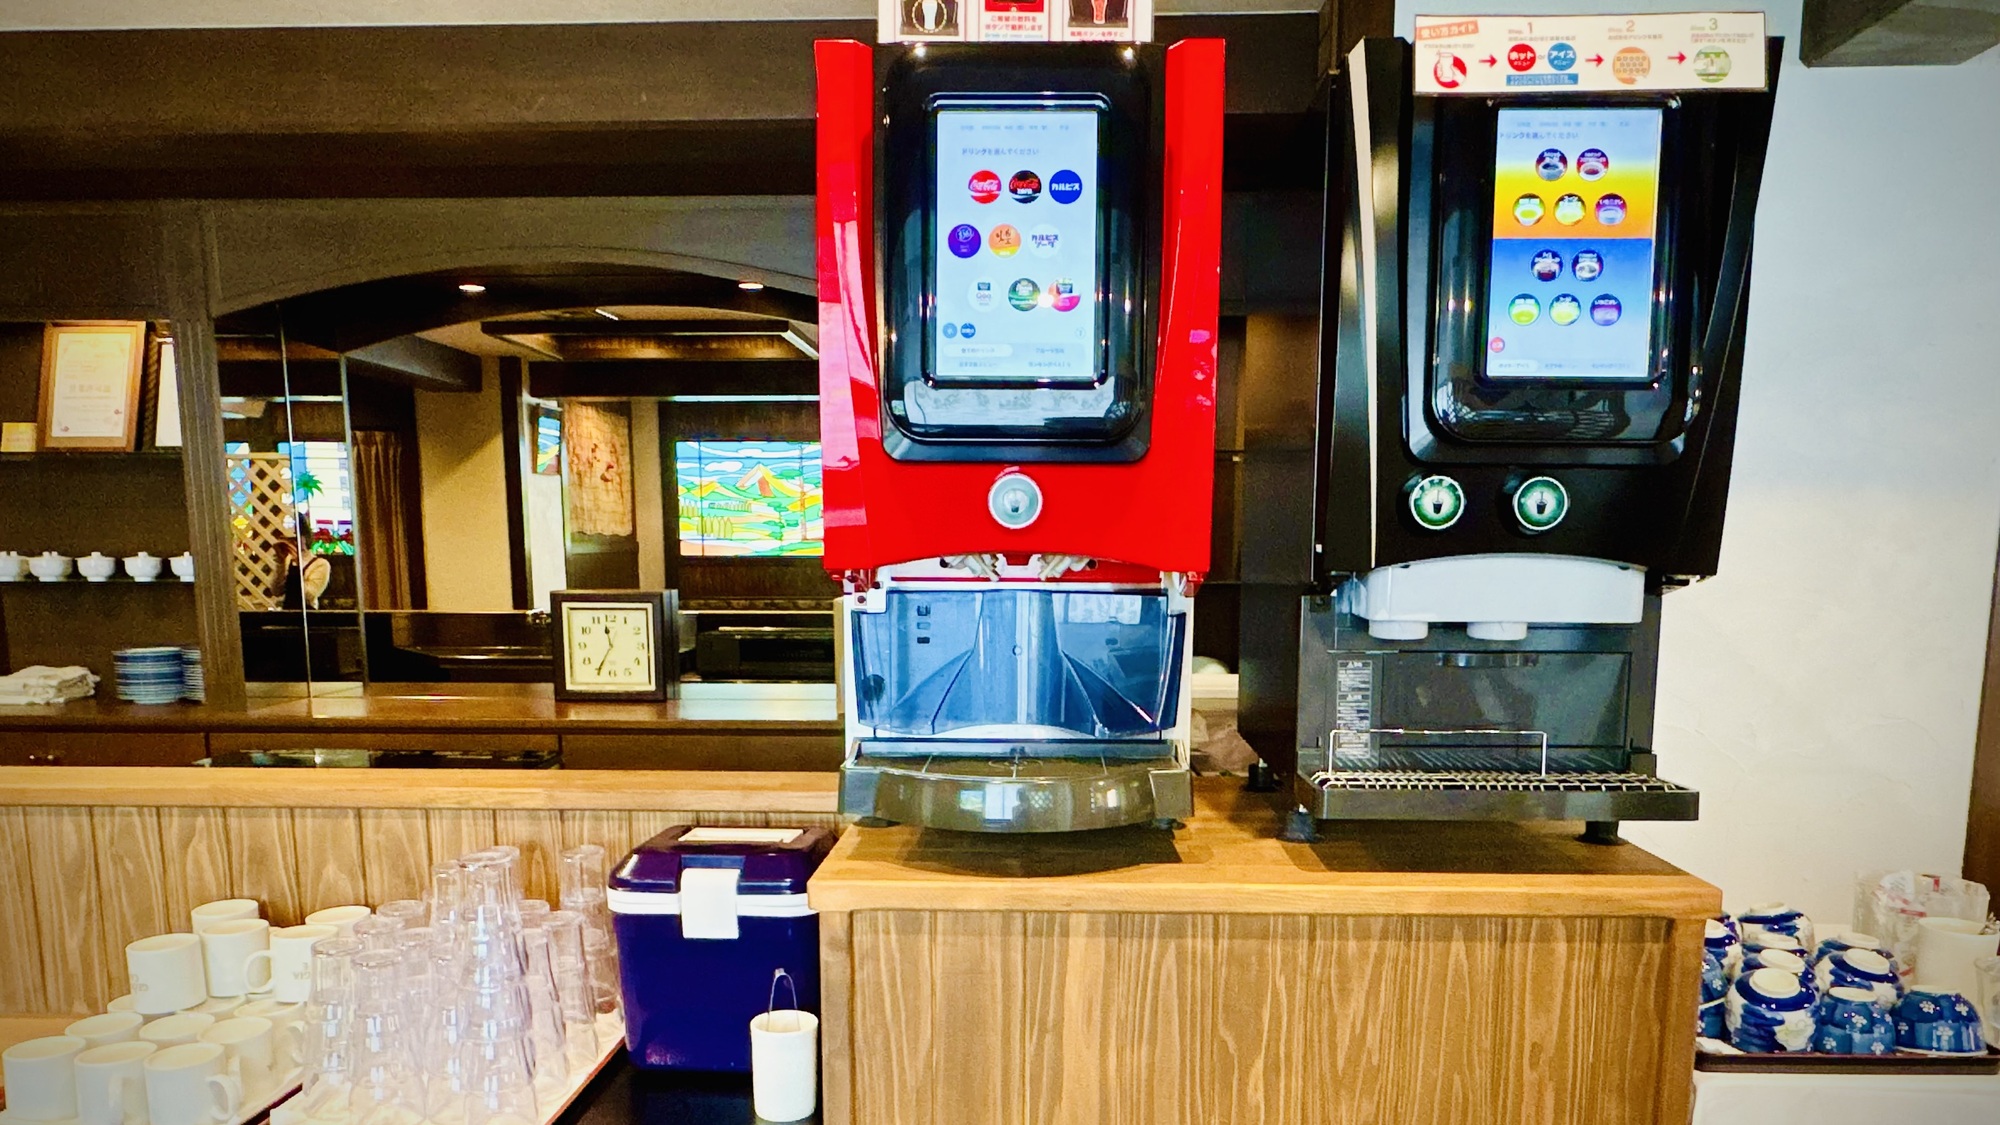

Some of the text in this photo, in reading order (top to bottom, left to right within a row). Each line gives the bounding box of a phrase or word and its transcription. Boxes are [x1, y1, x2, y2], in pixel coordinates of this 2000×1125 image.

[1528, 22, 1532, 34] 1
[1626, 20, 1635, 33] 2
[1709, 18, 1718, 31] 3
[1509, 51, 1535, 60] ホット
[1549, 50, 1575, 59] アイス
[1051, 182, 1080, 191] カルピス
[1031, 234, 1058, 242] カルピス
[592, 616, 600, 624] 11
[605, 614, 616, 622] 12
[623, 616, 626, 624] 1
[581, 626, 592, 634] 10
[633, 627, 640, 635] 2
[582, 657, 592, 665] 8
[634, 657, 640, 665] 4
[608, 669, 616, 677] 6
